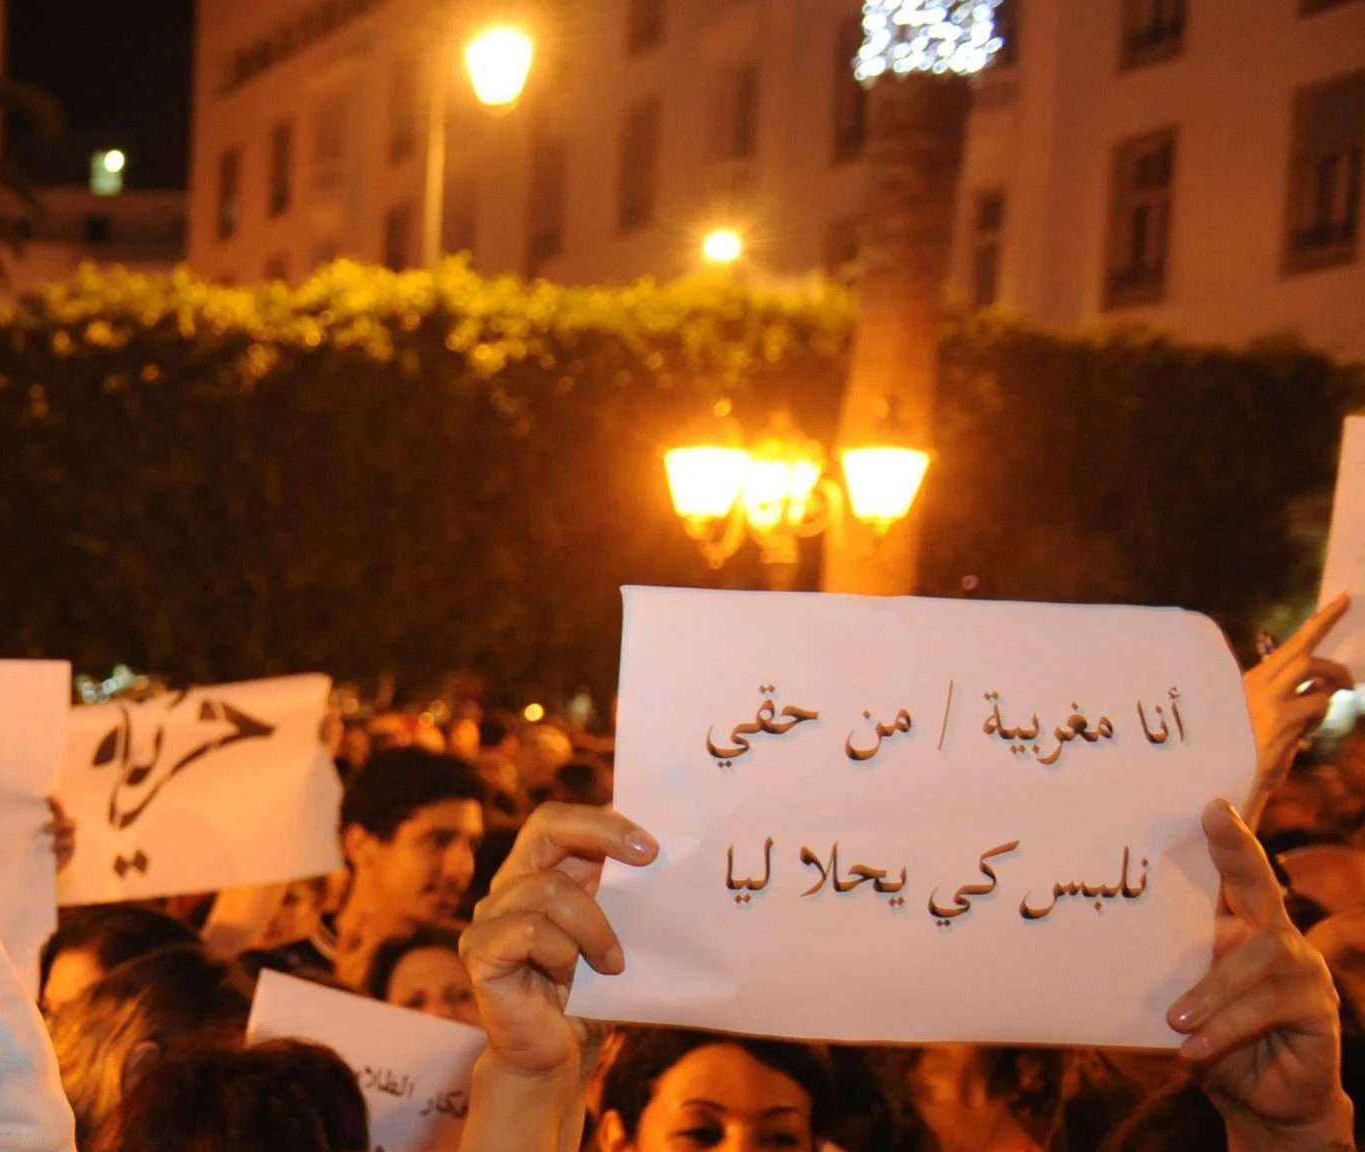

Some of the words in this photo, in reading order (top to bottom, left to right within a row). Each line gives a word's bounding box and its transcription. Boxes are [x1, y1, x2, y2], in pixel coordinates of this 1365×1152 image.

[705, 684, 819, 769] حقي
[844, 706, 913, 761] من
[982, 690, 1115, 765] مغربية
[1136, 686, 1185, 745] أنا
[725, 835, 775, 905] ليا
[799, 840, 908, 907] يحلا
[926, 839, 1021, 927] كي
[1018, 844, 1149, 920] نلبس
